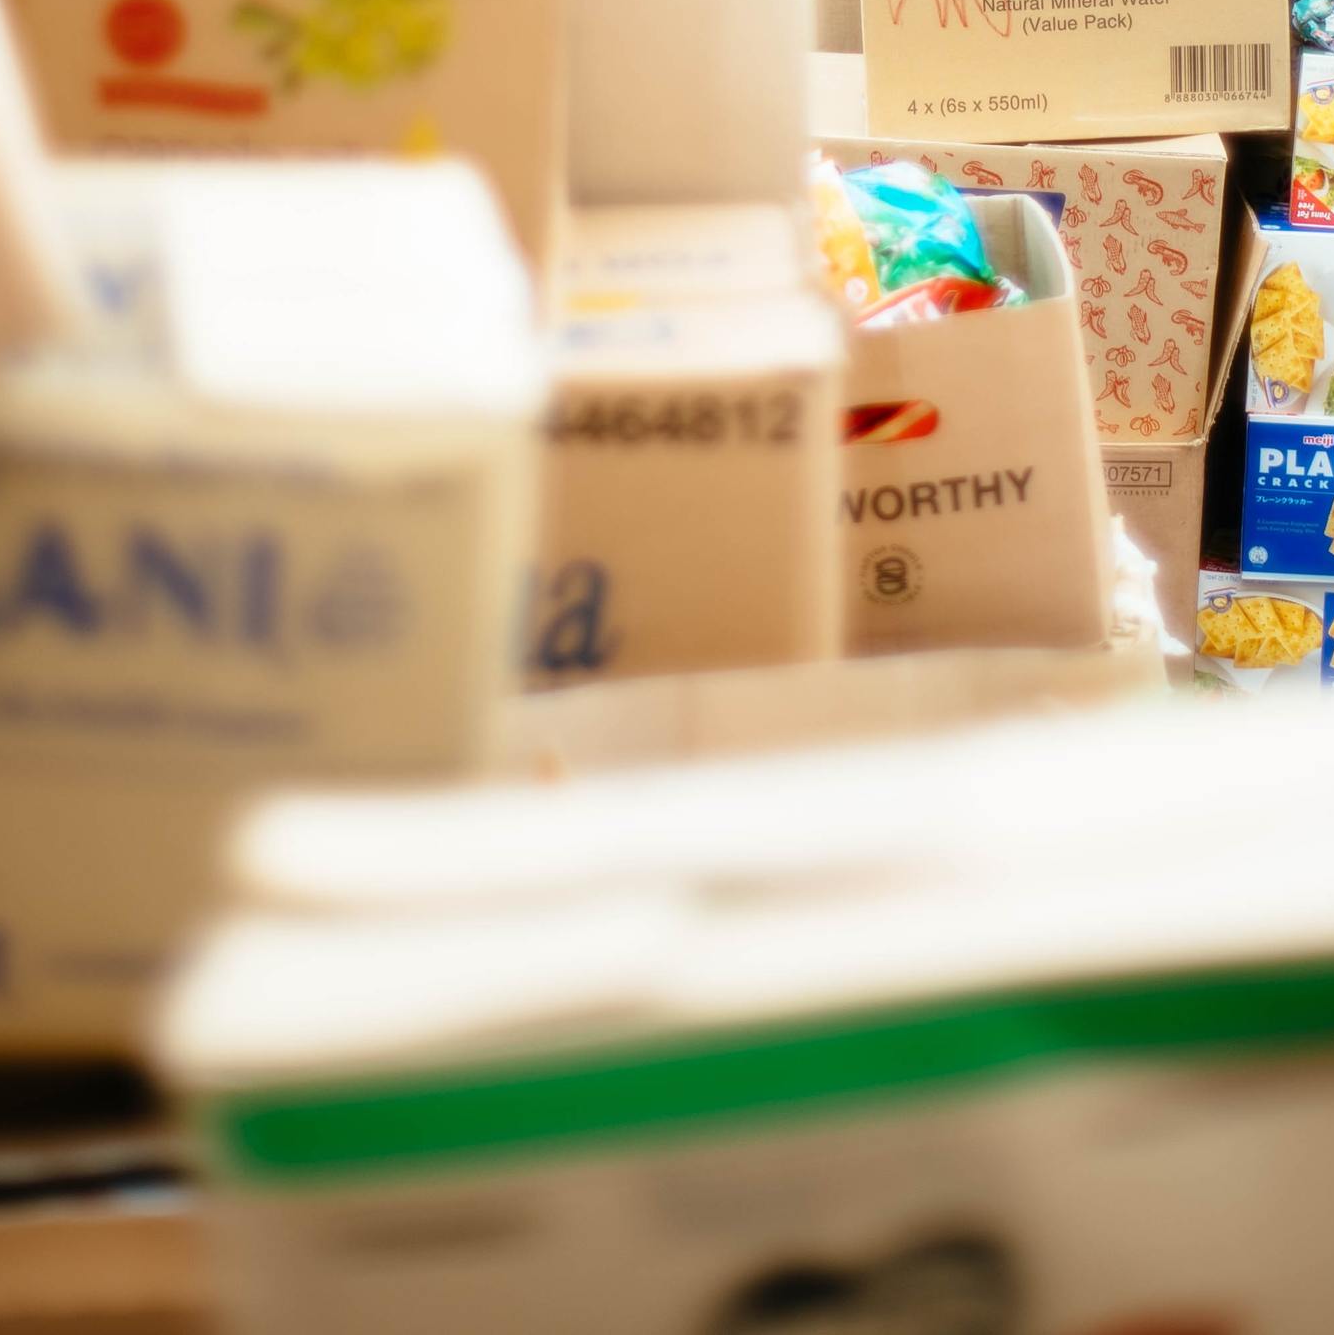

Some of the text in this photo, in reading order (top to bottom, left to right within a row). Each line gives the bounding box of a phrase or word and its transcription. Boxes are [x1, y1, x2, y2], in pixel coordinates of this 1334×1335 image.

[1022, 13, 1133, 35] (Value Pack)
[907, 94, 1048, 116] 4 x (6s x 550ml)
[1303, 434, 1334, 448] meiji
